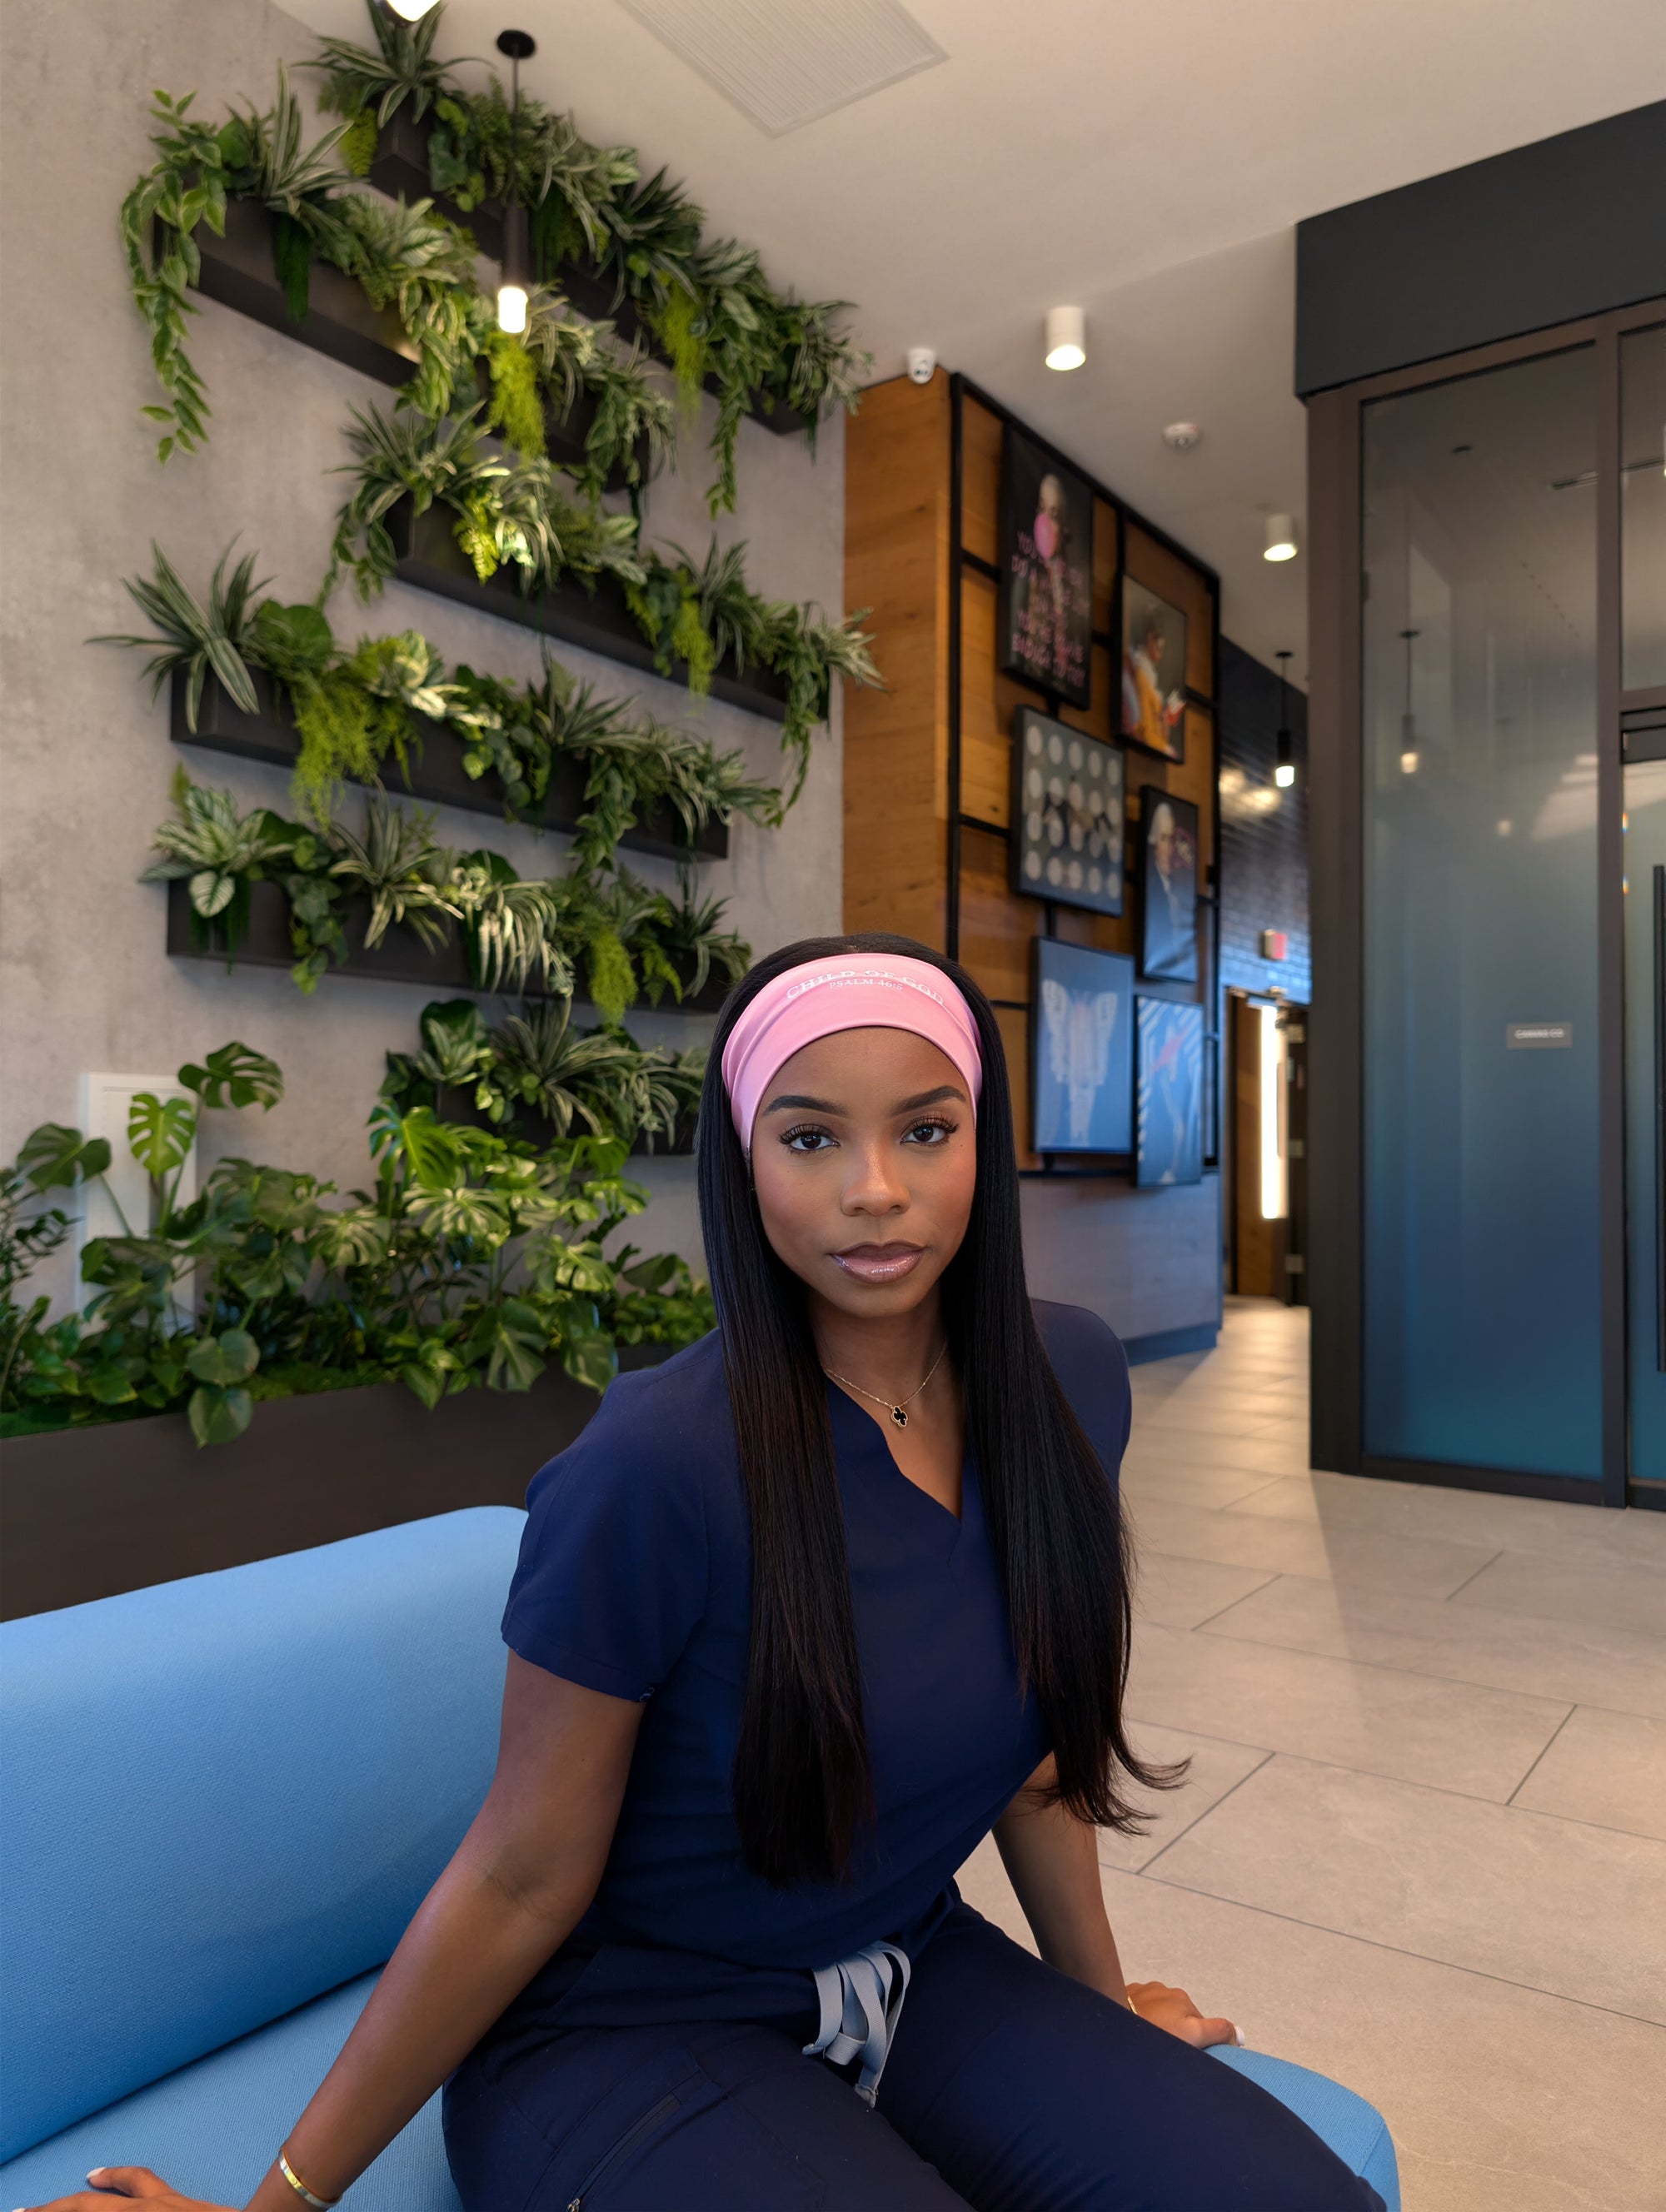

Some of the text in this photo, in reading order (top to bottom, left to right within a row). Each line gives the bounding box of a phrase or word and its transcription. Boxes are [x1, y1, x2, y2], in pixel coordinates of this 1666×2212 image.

[786, 970, 856, 999] CHILD
[902, 976, 945, 1005] GOD
[829, 979, 903, 991] PSALM 46:5
